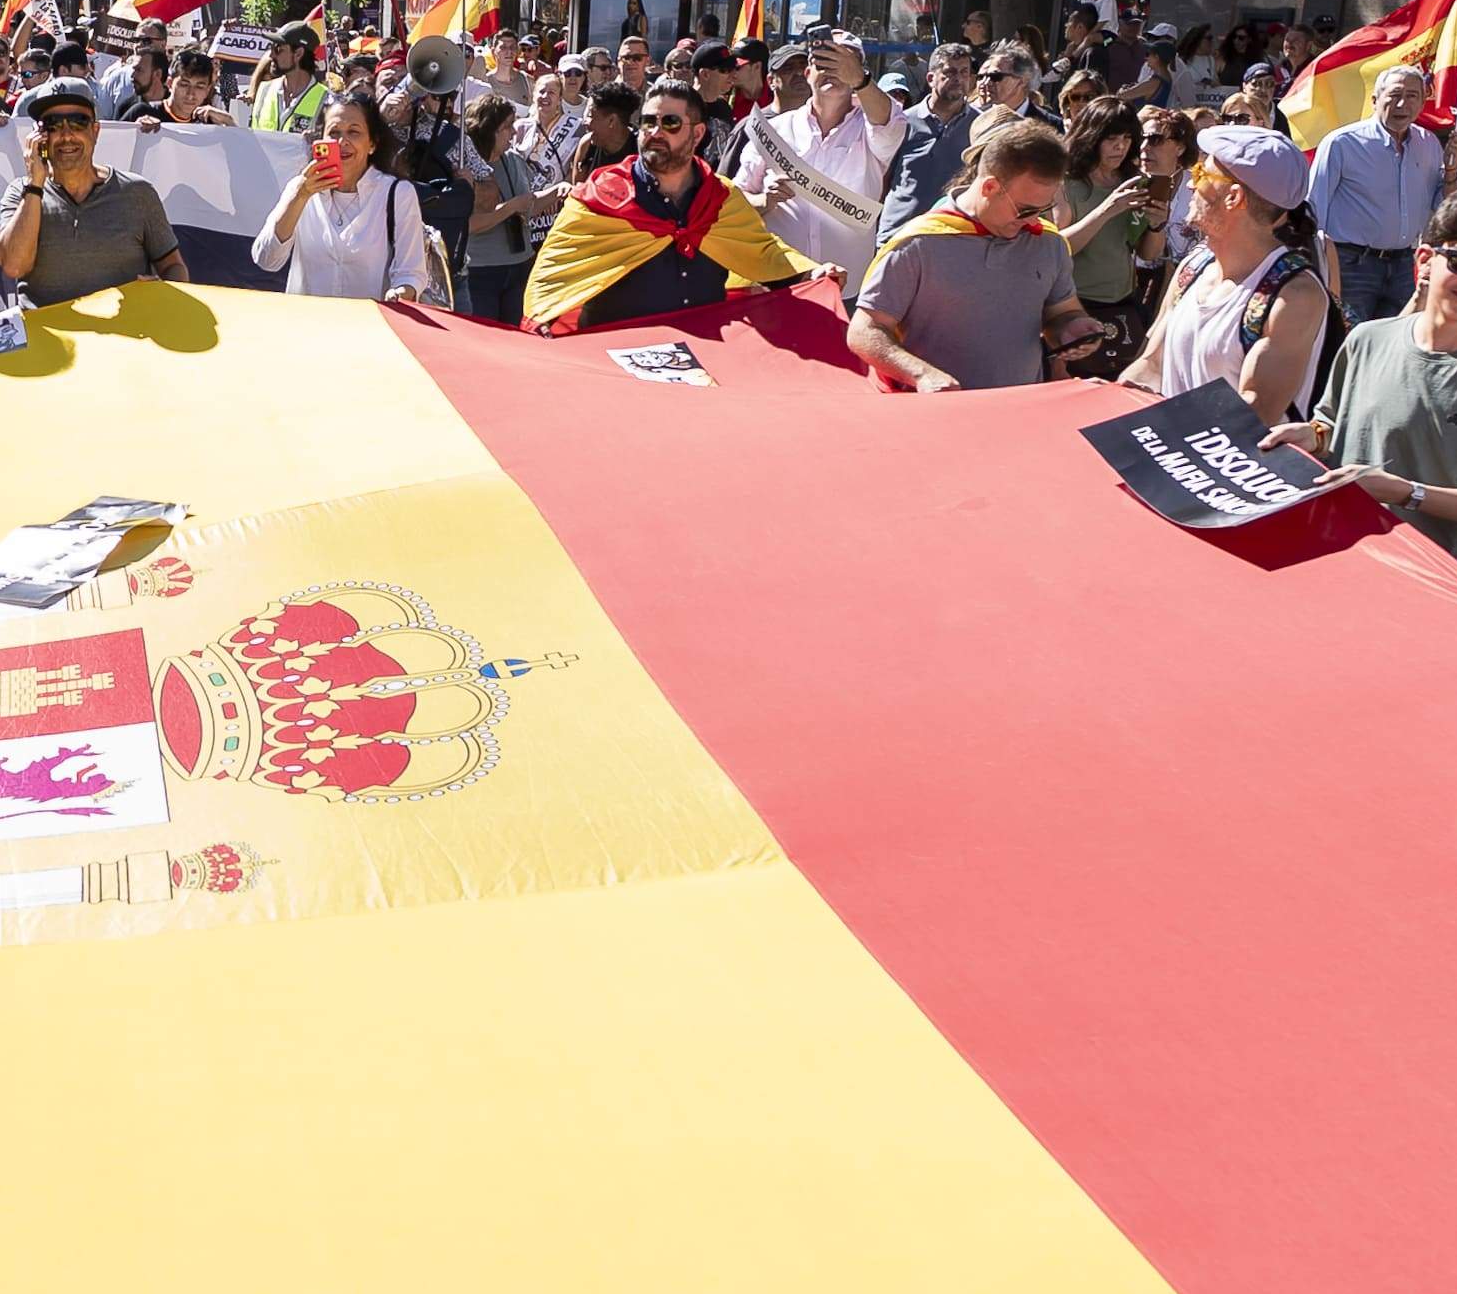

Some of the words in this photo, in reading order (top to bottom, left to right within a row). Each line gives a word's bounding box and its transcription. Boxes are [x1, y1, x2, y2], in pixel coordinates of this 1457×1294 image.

[774, 151, 795, 175] DEBE
[1130, 425, 1150, 445] DE
[1142, 438, 1163, 457] LA
[1155, 451, 1219, 493] MAFIA
